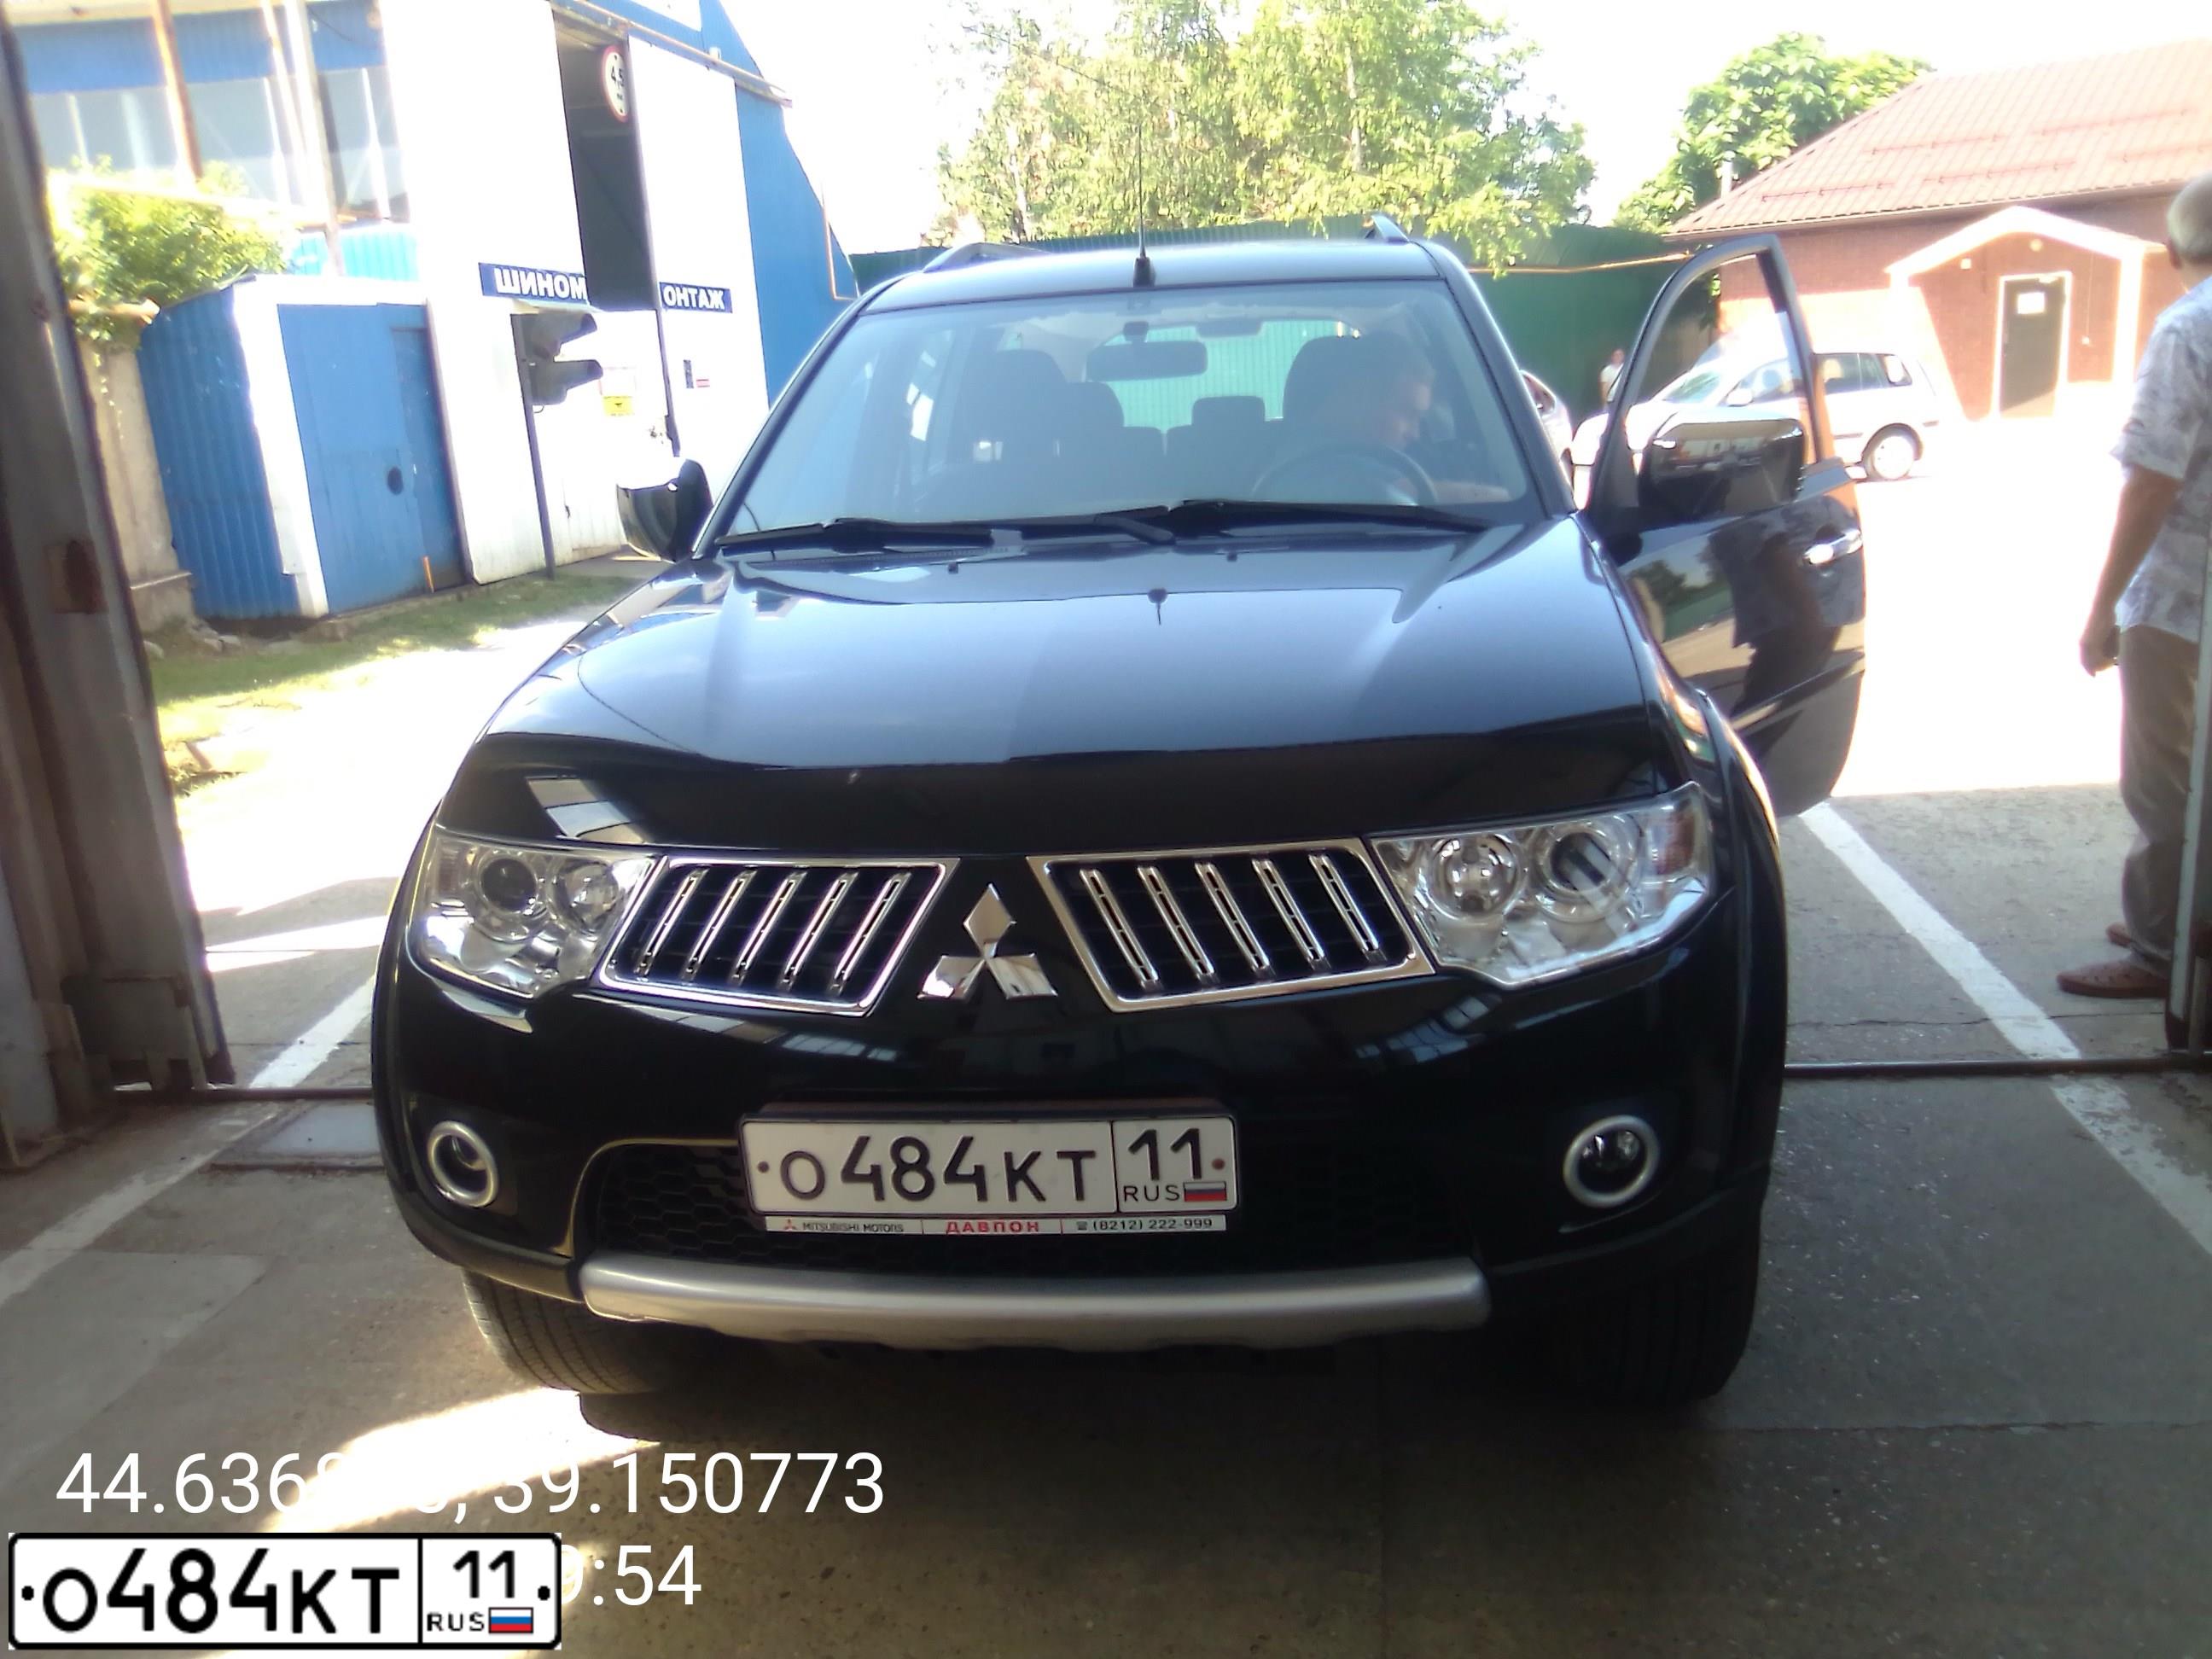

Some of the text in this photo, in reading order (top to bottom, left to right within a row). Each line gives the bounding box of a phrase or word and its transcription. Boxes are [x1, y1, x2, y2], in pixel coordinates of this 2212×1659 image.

[493, 268, 725, 309] ШИНОМ ОНТАЖ
[1129, 1128, 1201, 1180] 11
[1123, 1185, 1181, 1202] RUS
[802, 1222, 904, 1232] MITSUBISHI MOTORS
[946, 1220, 1039, 1234] ДАВПОН
[1093, 1220, 1143, 1231] (8212)
